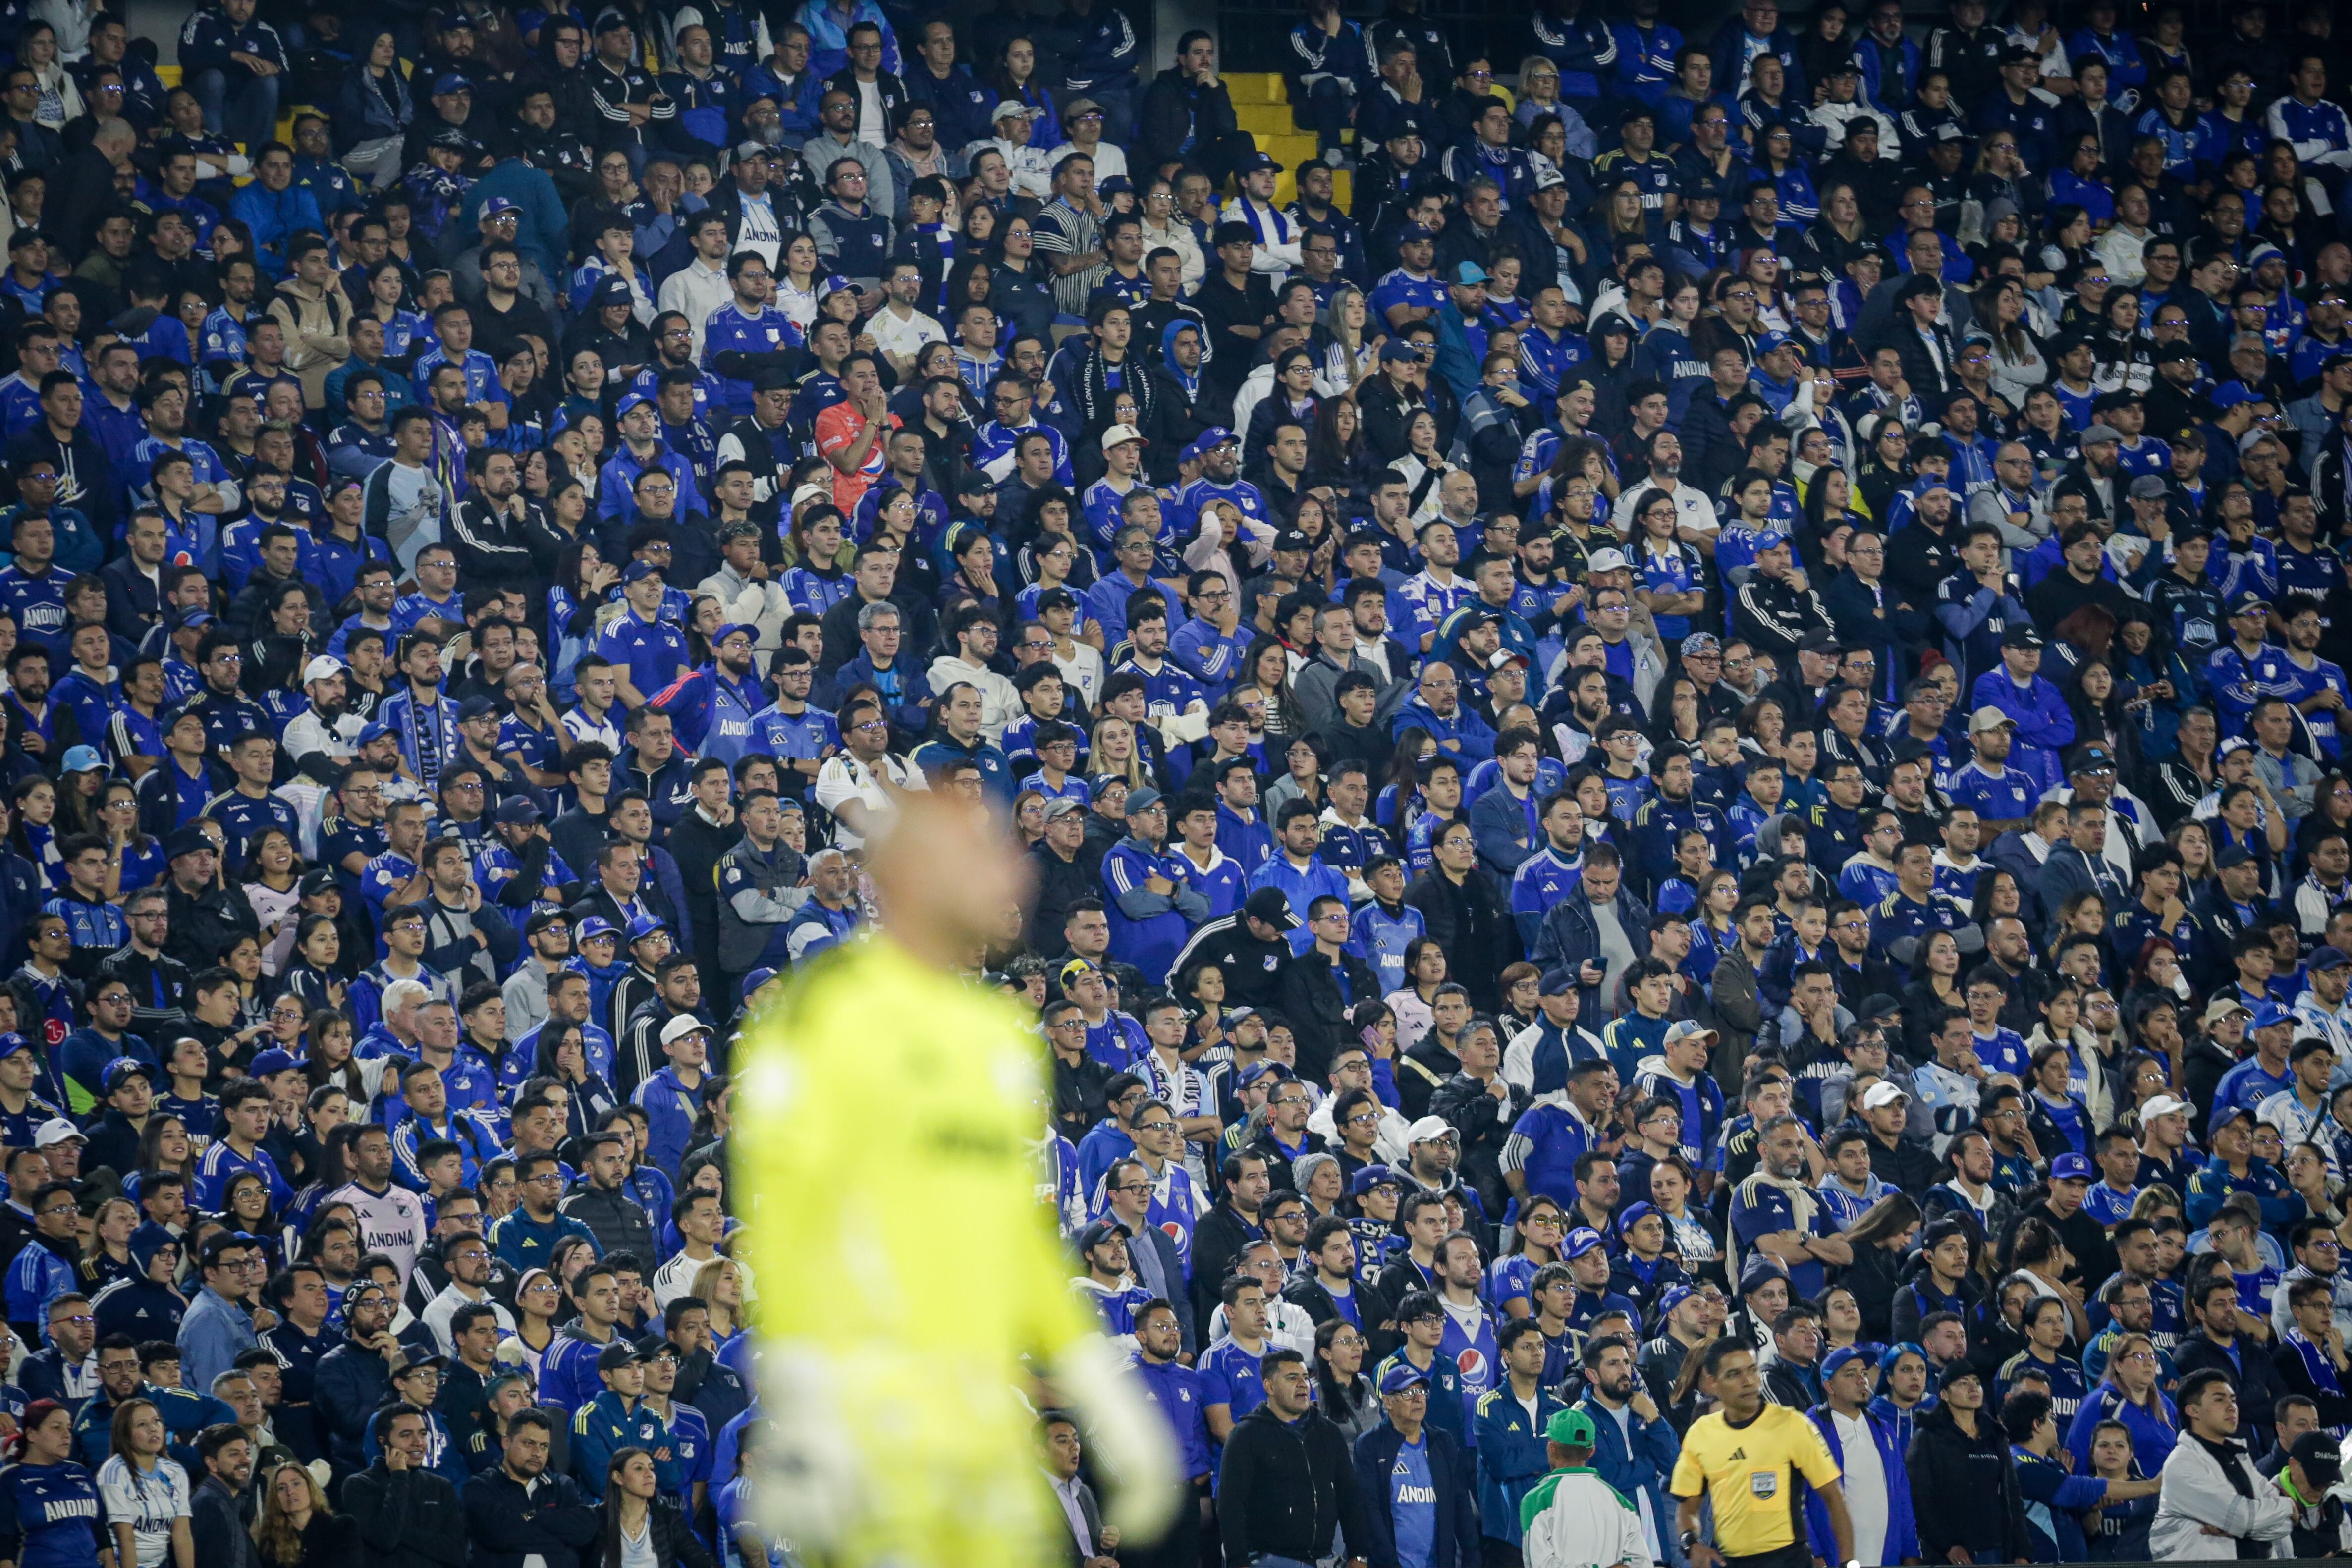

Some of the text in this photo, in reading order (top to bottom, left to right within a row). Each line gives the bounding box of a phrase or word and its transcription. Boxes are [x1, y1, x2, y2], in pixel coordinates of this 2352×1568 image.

[744, 227, 782, 243] ANDIN
[1673, 360, 1712, 379] ANDIN
[719, 719, 747, 735] ANDI
[1380, 953, 1405, 967] ANDI
[368, 1229, 413, 1249] ANDINA
[44, 1498, 98, 1522] ANDINA
